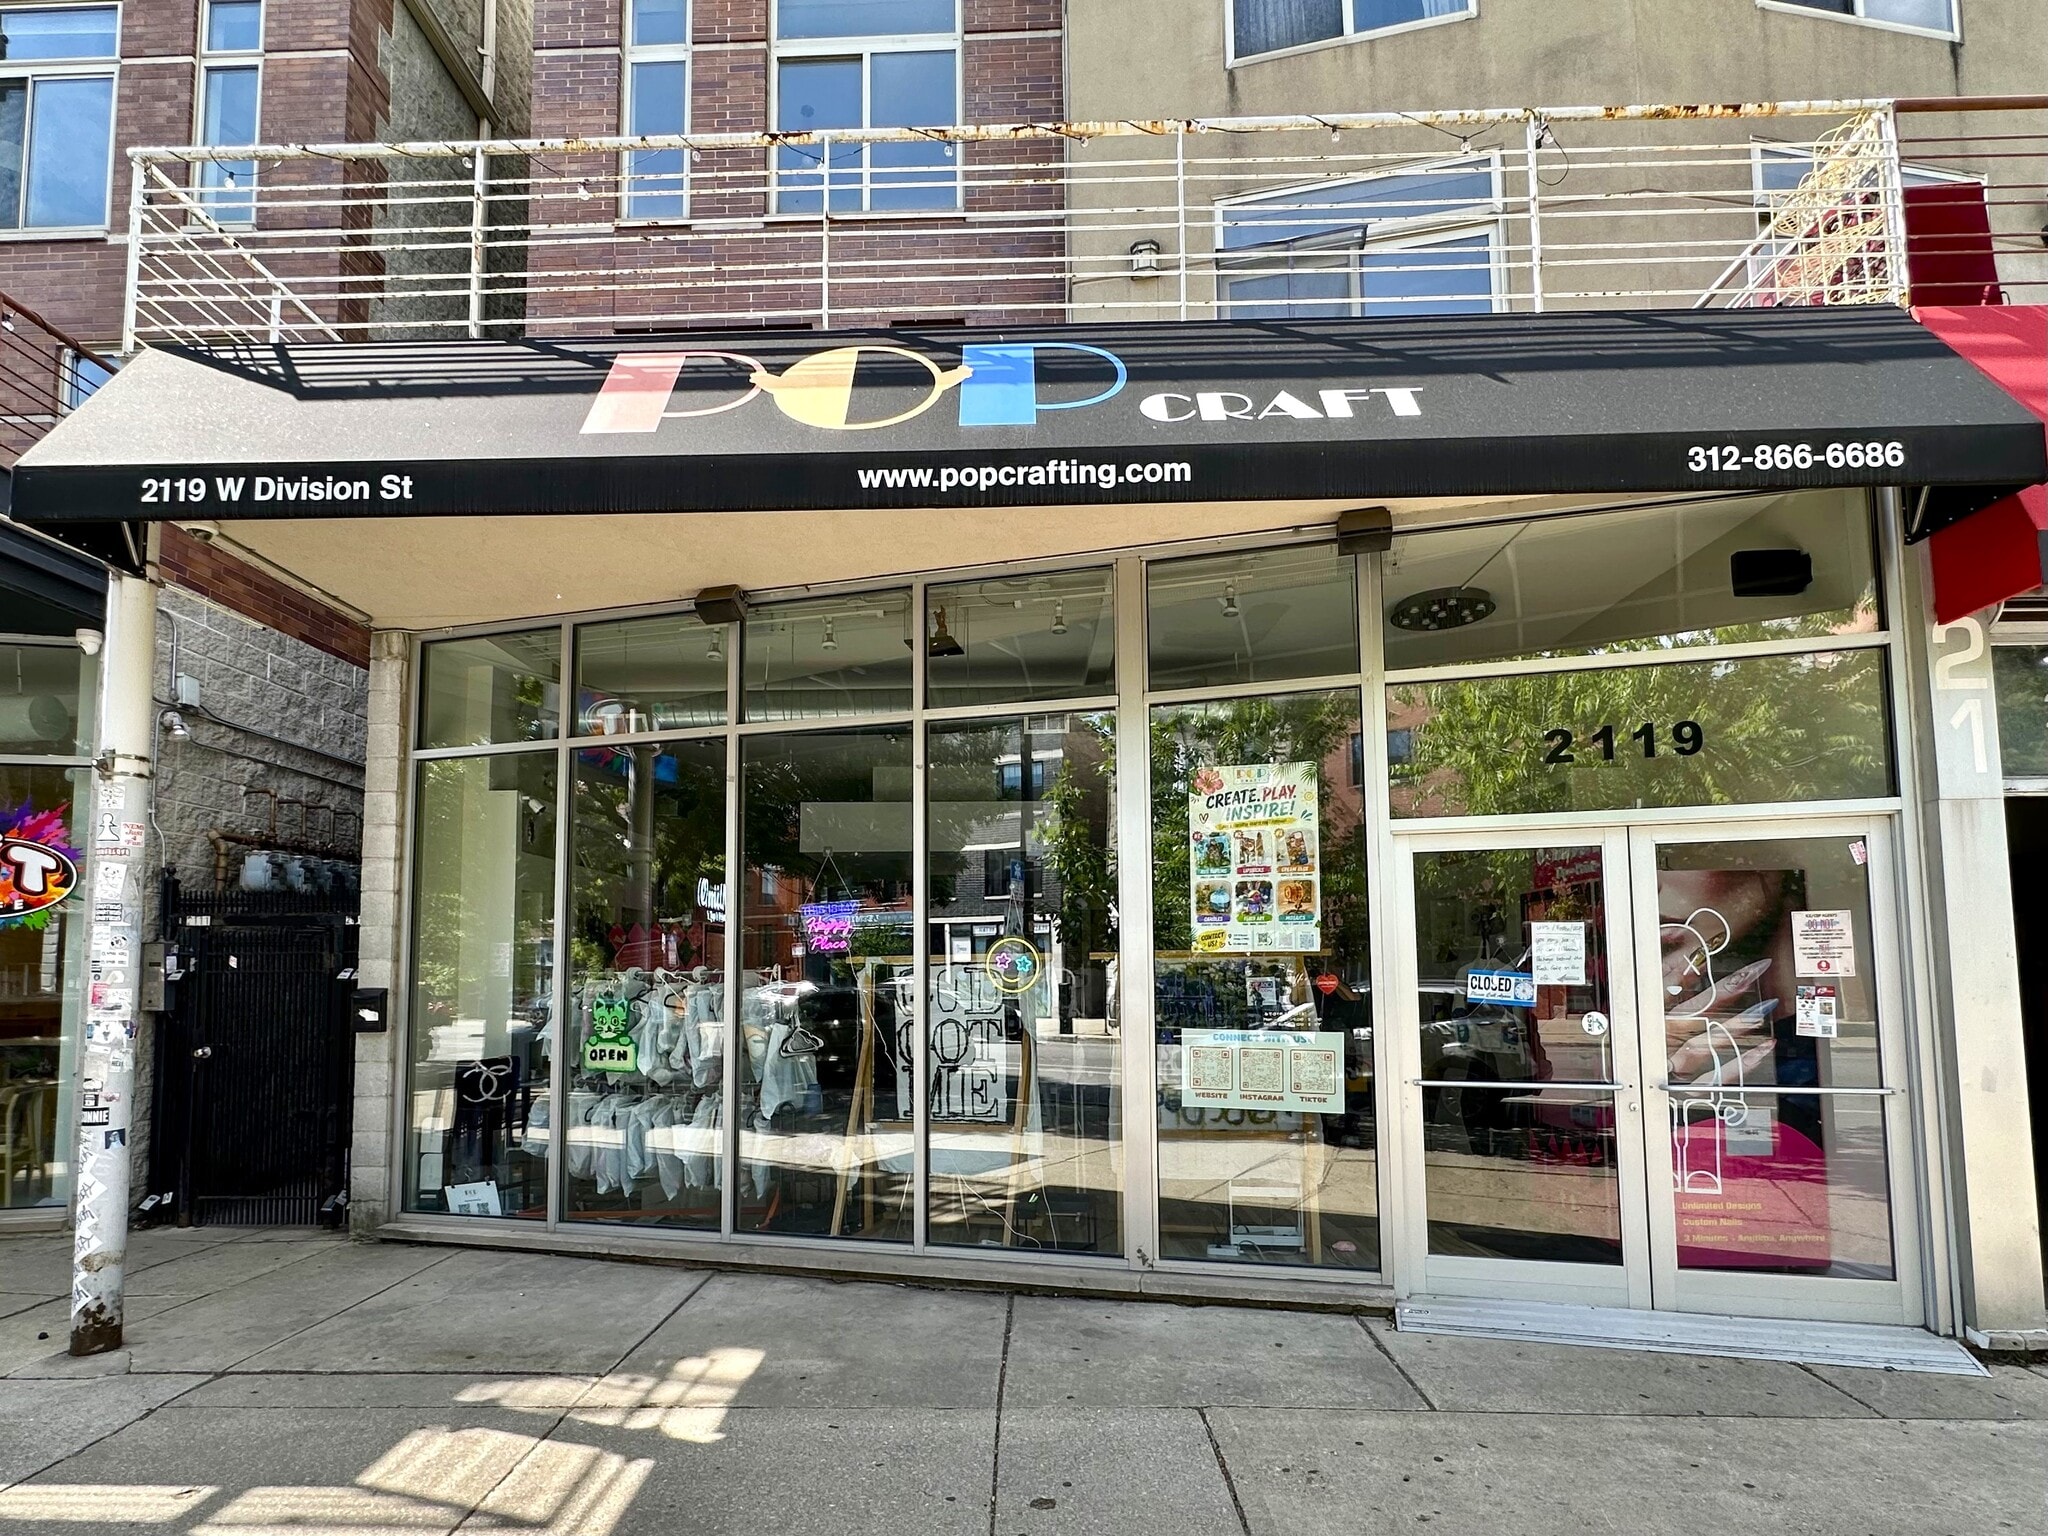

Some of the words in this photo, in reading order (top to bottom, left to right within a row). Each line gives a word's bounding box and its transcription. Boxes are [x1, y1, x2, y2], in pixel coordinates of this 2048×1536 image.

[579, 342, 1127, 434] POP
[1139, 387, 1424, 422] CRAFT
[1687, 441, 1905, 472] 312-866-6686
[857, 459, 1192, 491] www.popcrafting.com
[141, 477, 206, 502] 2119
[216, 477, 246, 501] W
[254, 475, 370, 501] Division
[379, 474, 413, 500] St
[1544, 720, 1704, 764] 2119
[1206, 788, 1260, 809] CREATE.
[1262, 785, 1297, 802] PLAY.
[1226, 801, 1296, 820] INSPIRE!
[806, 916, 853, 935] Happy
[810, 935, 848, 951] Place
[1470, 976, 1512, 991] CLOSED
[589, 1049, 628, 1061] OPEN
[1239, 1093, 1284, 1101] INSTAGRAM
[1682, 1202, 1724, 1210] Unlimited
[1726, 1202, 1762, 1211] Designs
[1683, 1218, 1718, 1226] Custom
[1720, 1218, 1743, 1226] Nails
